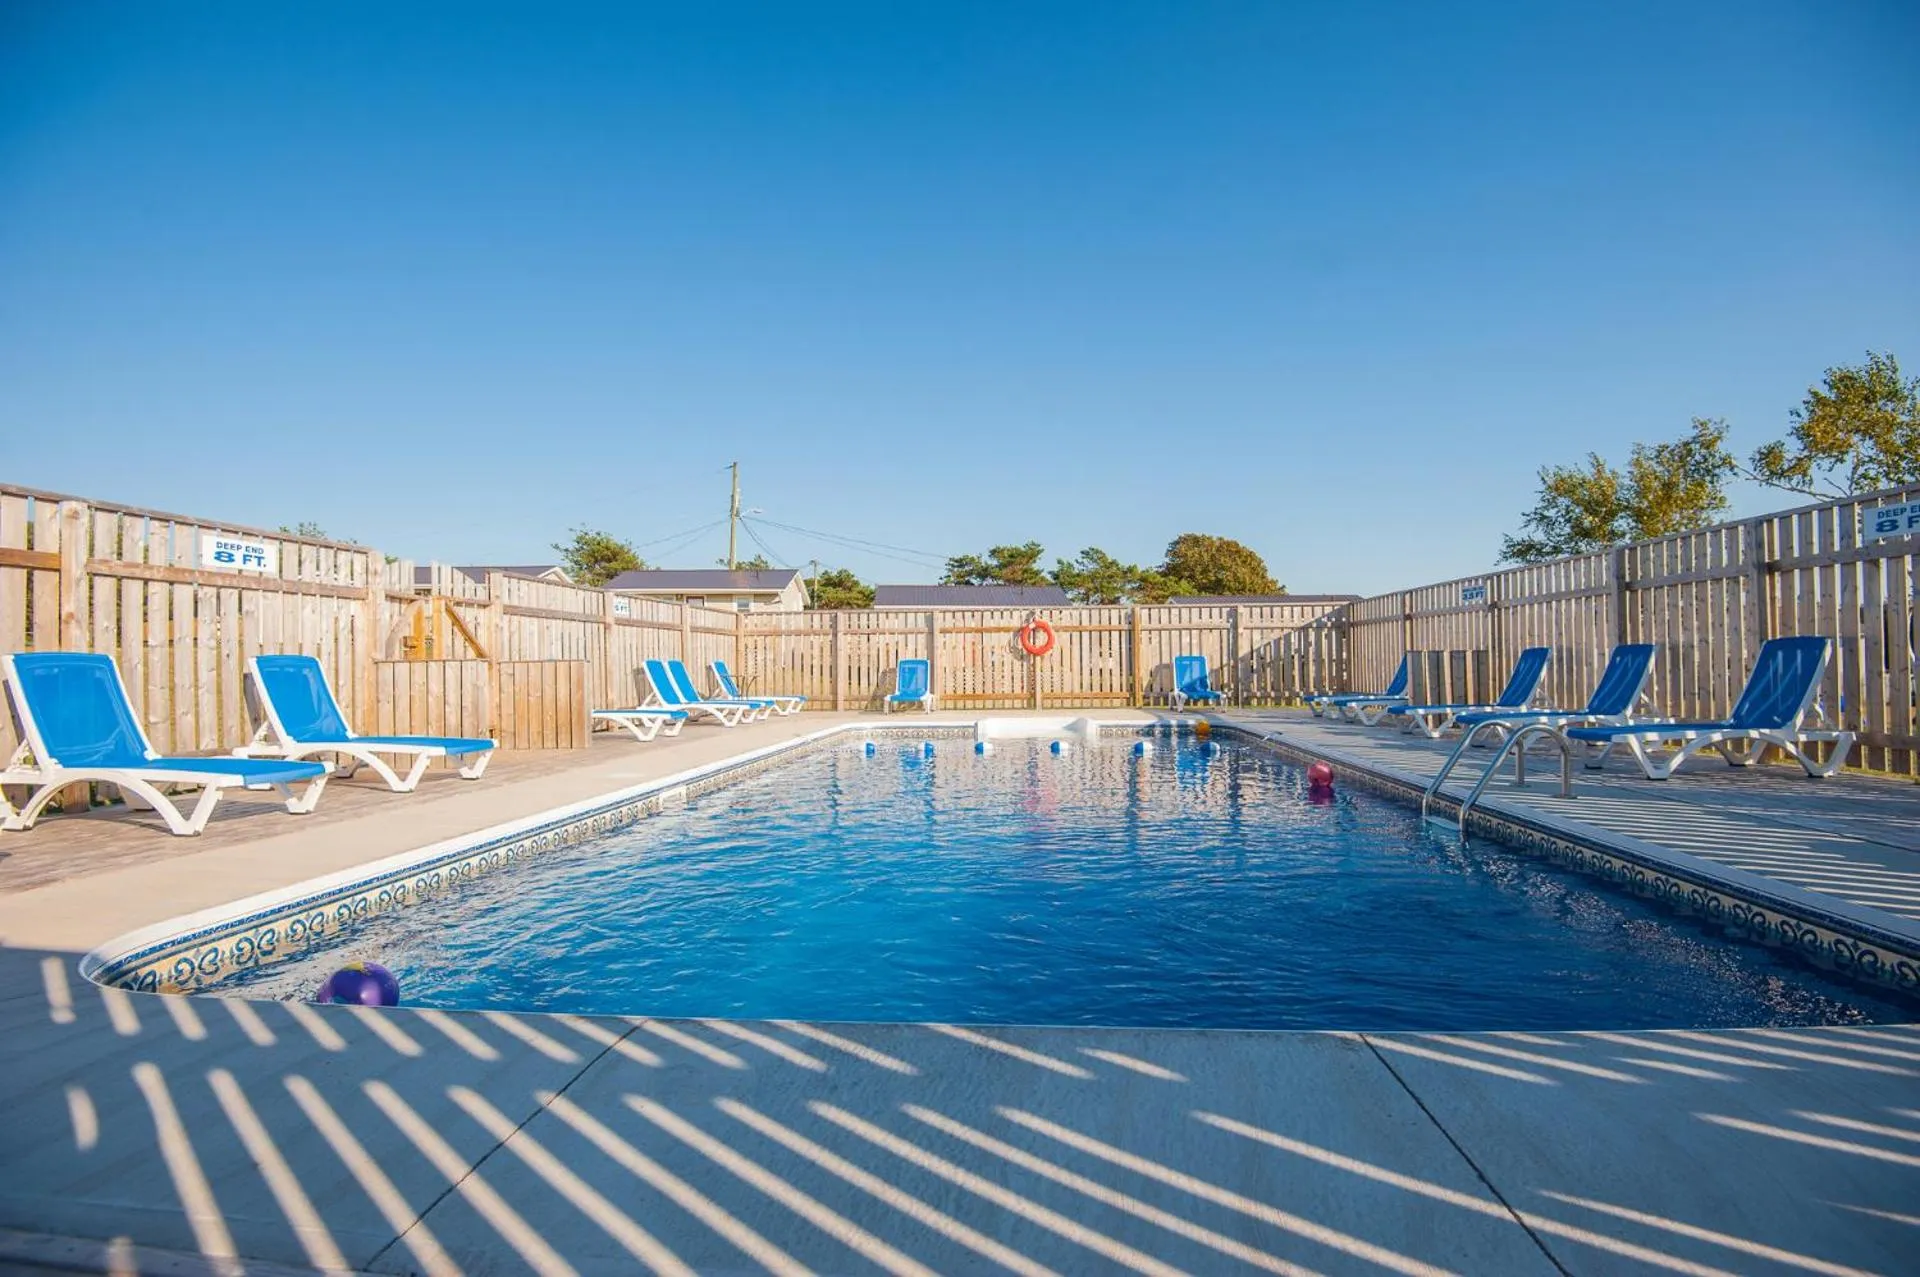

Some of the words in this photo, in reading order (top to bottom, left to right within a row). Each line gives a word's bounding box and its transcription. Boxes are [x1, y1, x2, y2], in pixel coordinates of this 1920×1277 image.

[1877, 507, 1907, 519] DEEP
[1910, 504, 1920, 513] E
[1876, 519, 1899, 532] 8
[216, 541, 242, 551] DEEP
[245, 545, 264, 554] END
[214, 551, 235, 563] 8
[242, 554, 267, 567] FT.
